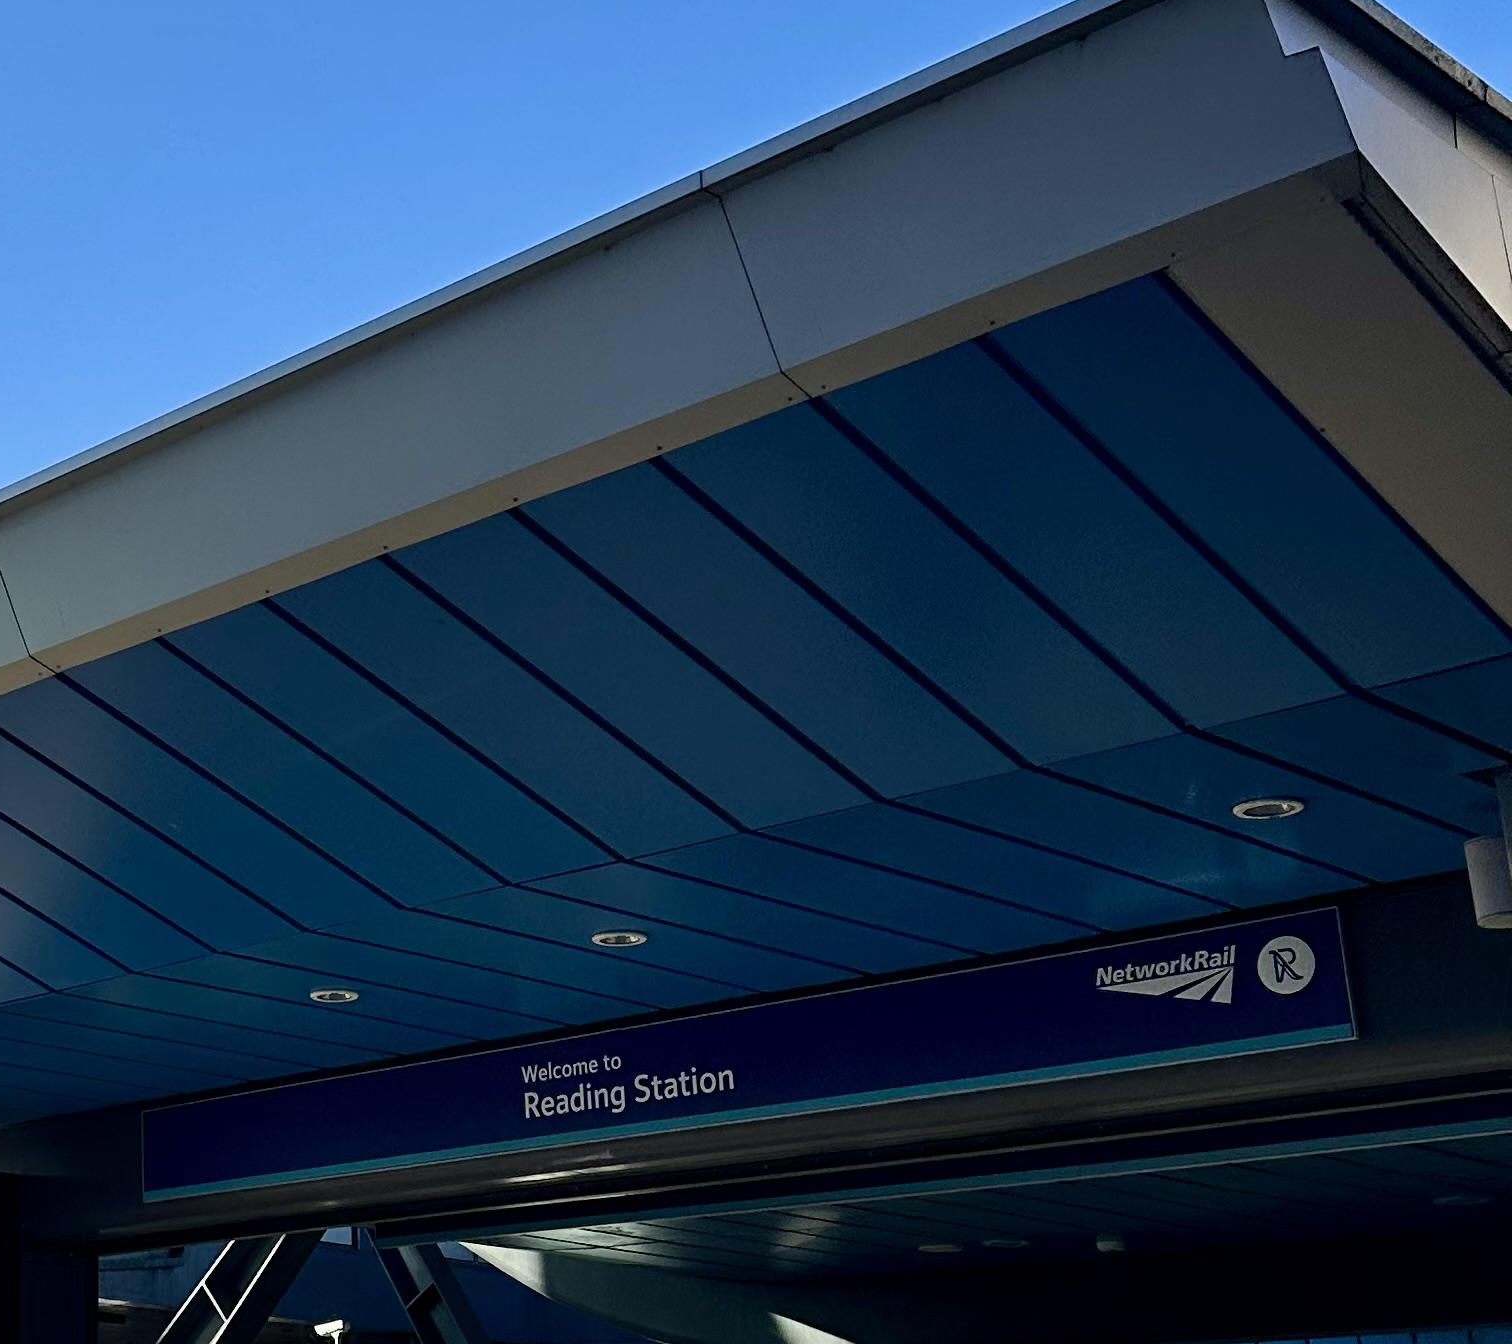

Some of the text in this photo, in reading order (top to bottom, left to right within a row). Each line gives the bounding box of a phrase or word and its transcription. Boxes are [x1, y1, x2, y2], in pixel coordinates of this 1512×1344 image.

[521, 1054, 622, 1084] Welcome to
[524, 1067, 736, 1120] Reading Station
